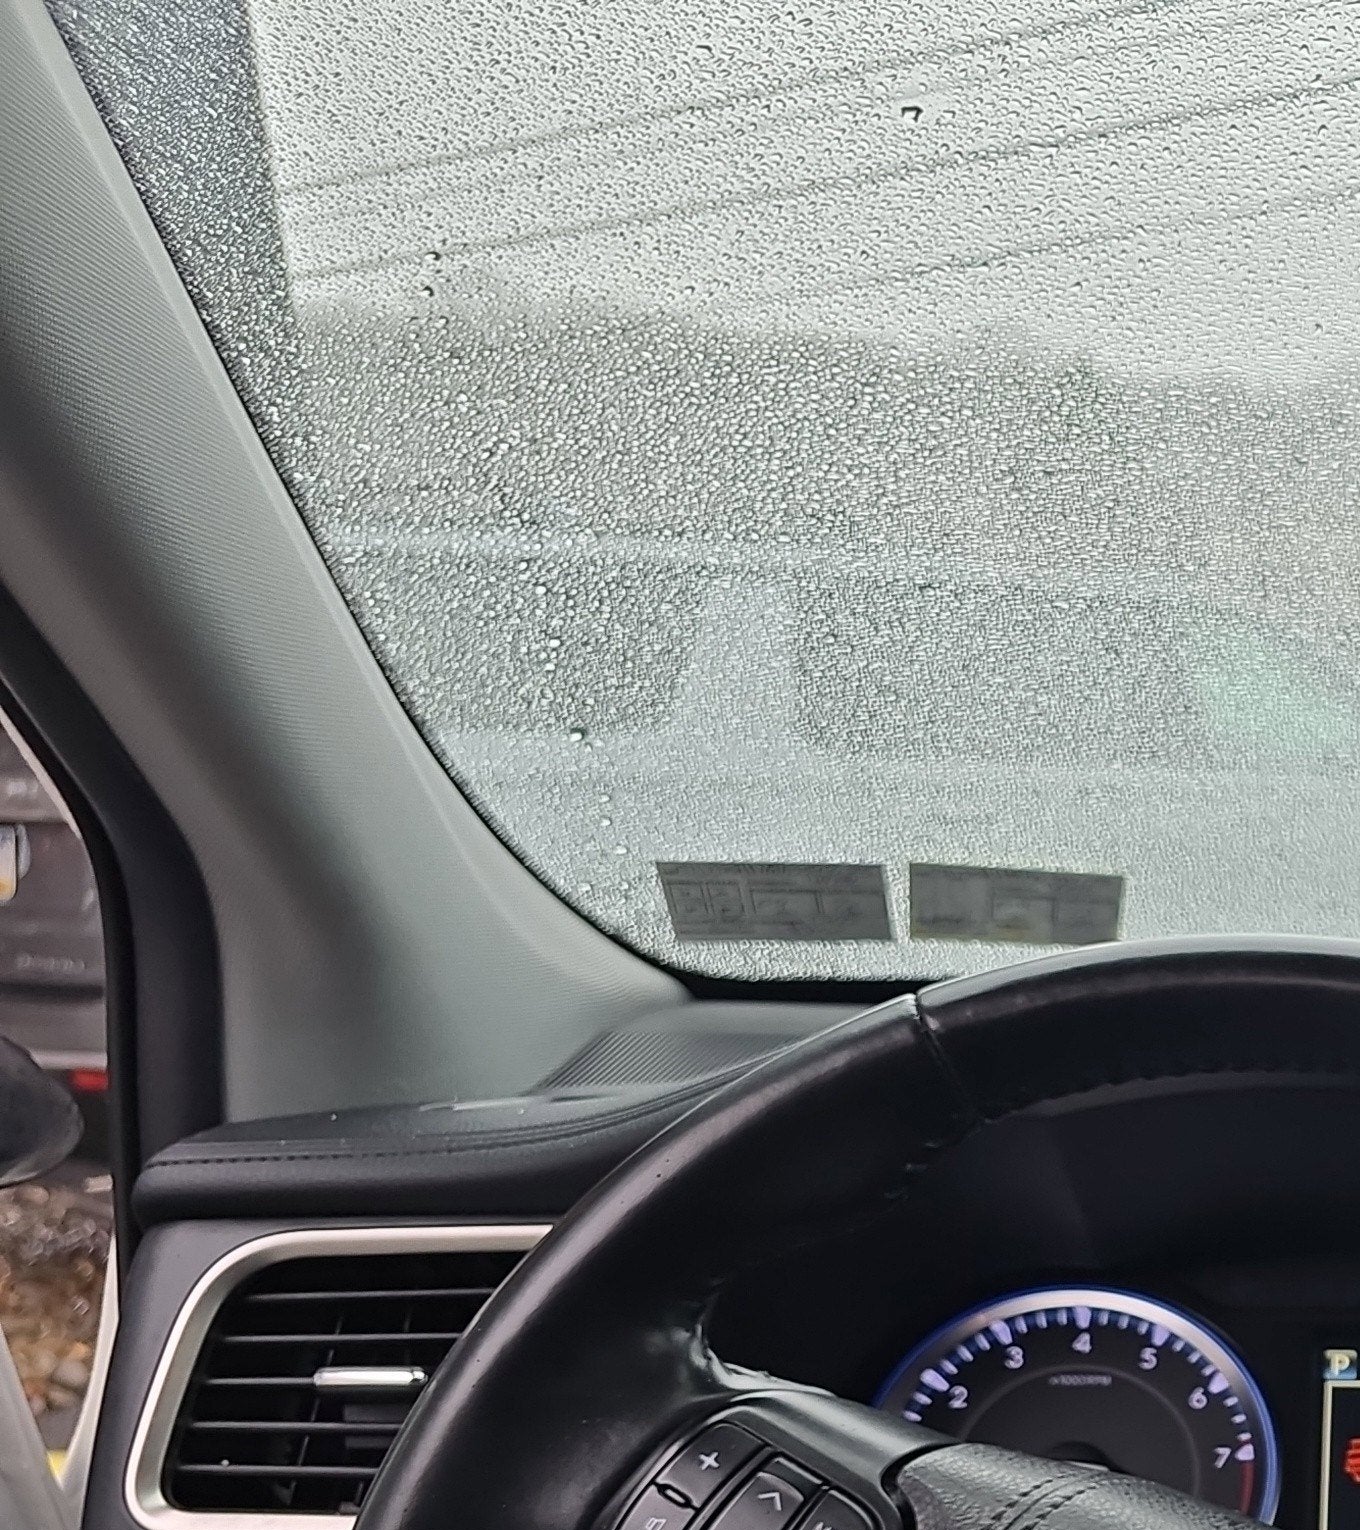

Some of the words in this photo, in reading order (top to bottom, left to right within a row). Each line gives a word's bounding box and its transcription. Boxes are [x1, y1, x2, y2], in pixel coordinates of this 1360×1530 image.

[1072, 1332, 1092, 1354] 4
[1004, 1346, 1025, 1370] 3
[1139, 1347, 1158, 1371] 5
[1331, 1353, 1350, 1376] P
[949, 1385, 968, 1409] 2
[1188, 1387, 1208, 1410] 6
[1214, 1446, 1231, 1469] 7
